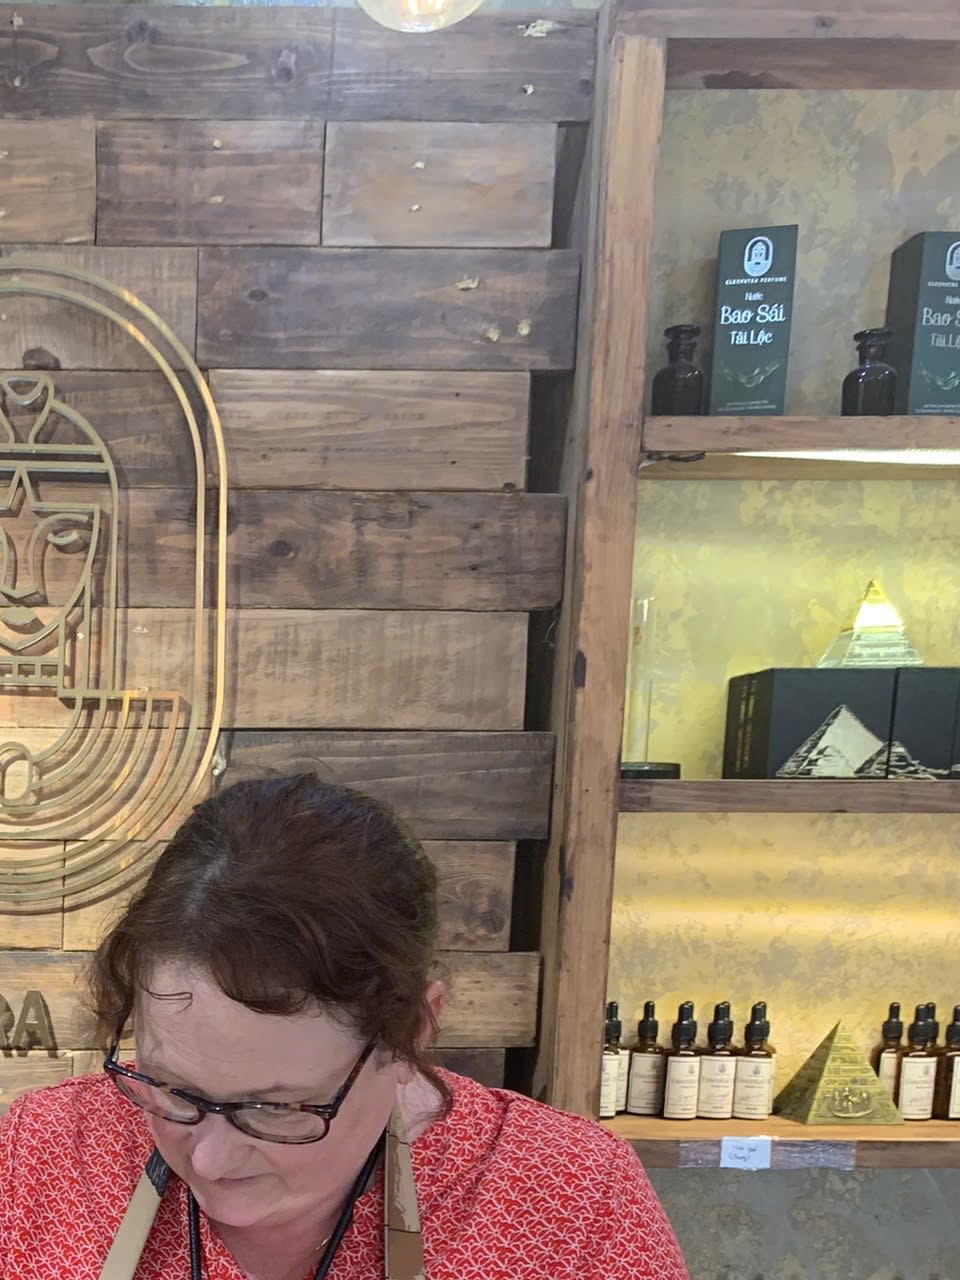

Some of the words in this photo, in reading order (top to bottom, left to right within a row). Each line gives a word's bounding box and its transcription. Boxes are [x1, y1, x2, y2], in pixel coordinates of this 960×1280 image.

[720, 305, 754, 325] Bao
[756, 303, 787, 323] Sái
[921, 306, 953, 326] Bao
